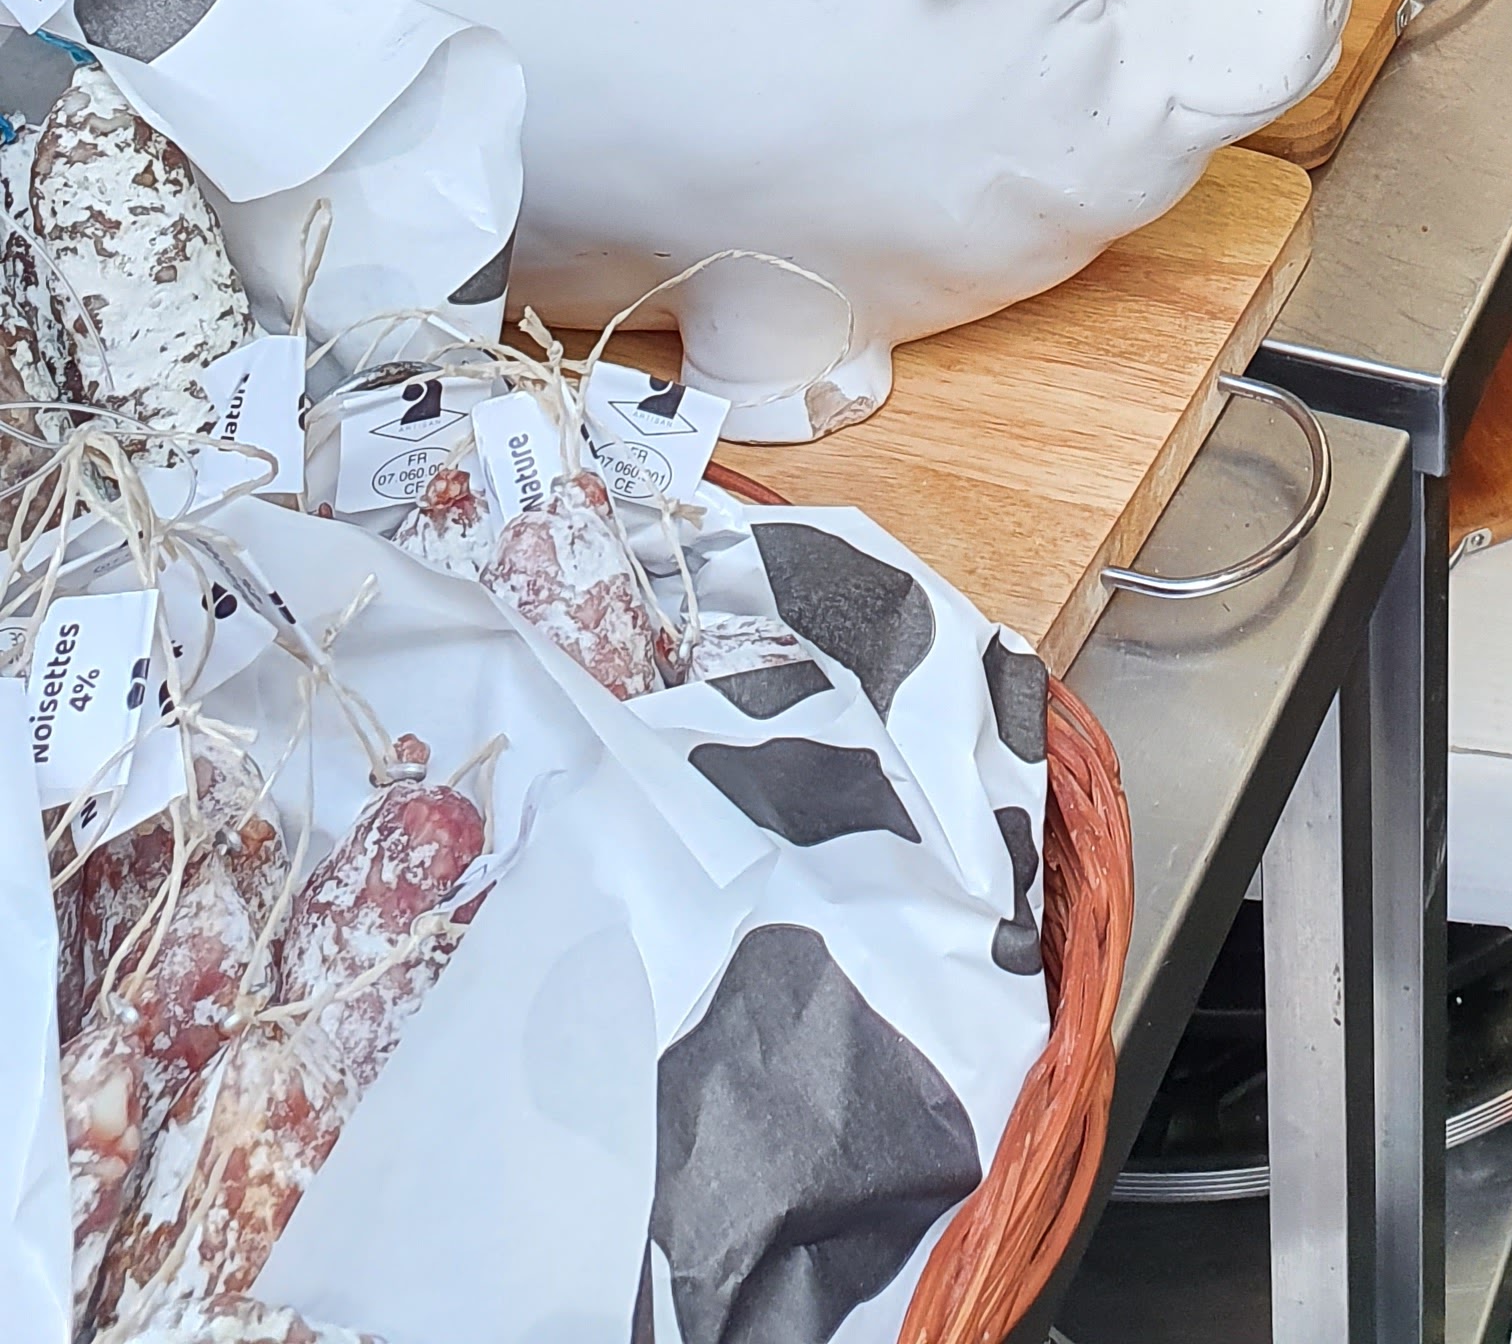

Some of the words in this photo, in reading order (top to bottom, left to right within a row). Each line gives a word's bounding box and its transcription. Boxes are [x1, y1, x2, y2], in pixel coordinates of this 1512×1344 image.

[408, 452, 427, 467] FR
[378, 462, 458, 486] 07.060.0
[613, 476, 634, 494] CE
[30, 623, 81, 764] Noisettes
[70, 667, 100, 713] 4%
